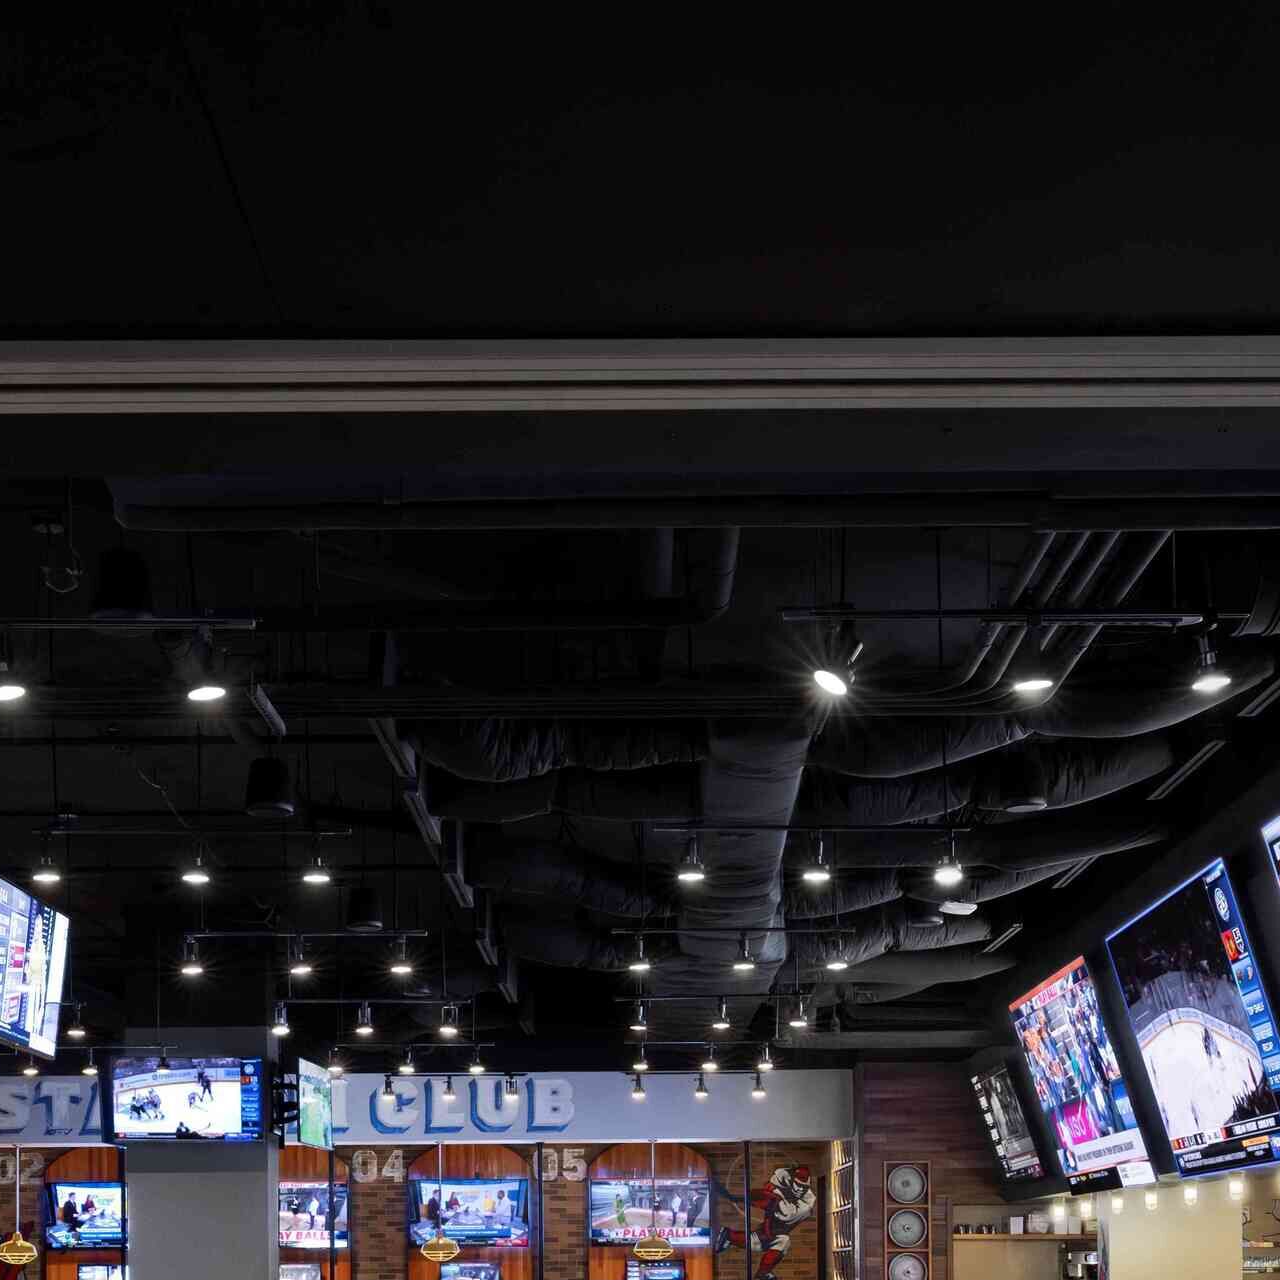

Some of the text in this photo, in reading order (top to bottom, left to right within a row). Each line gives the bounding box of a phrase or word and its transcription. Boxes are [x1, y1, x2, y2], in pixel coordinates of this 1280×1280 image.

[370, 1076, 575, 1134] CLUB
[351, 1149, 407, 1184] 04
[532, 1148, 587, 1182] 05
